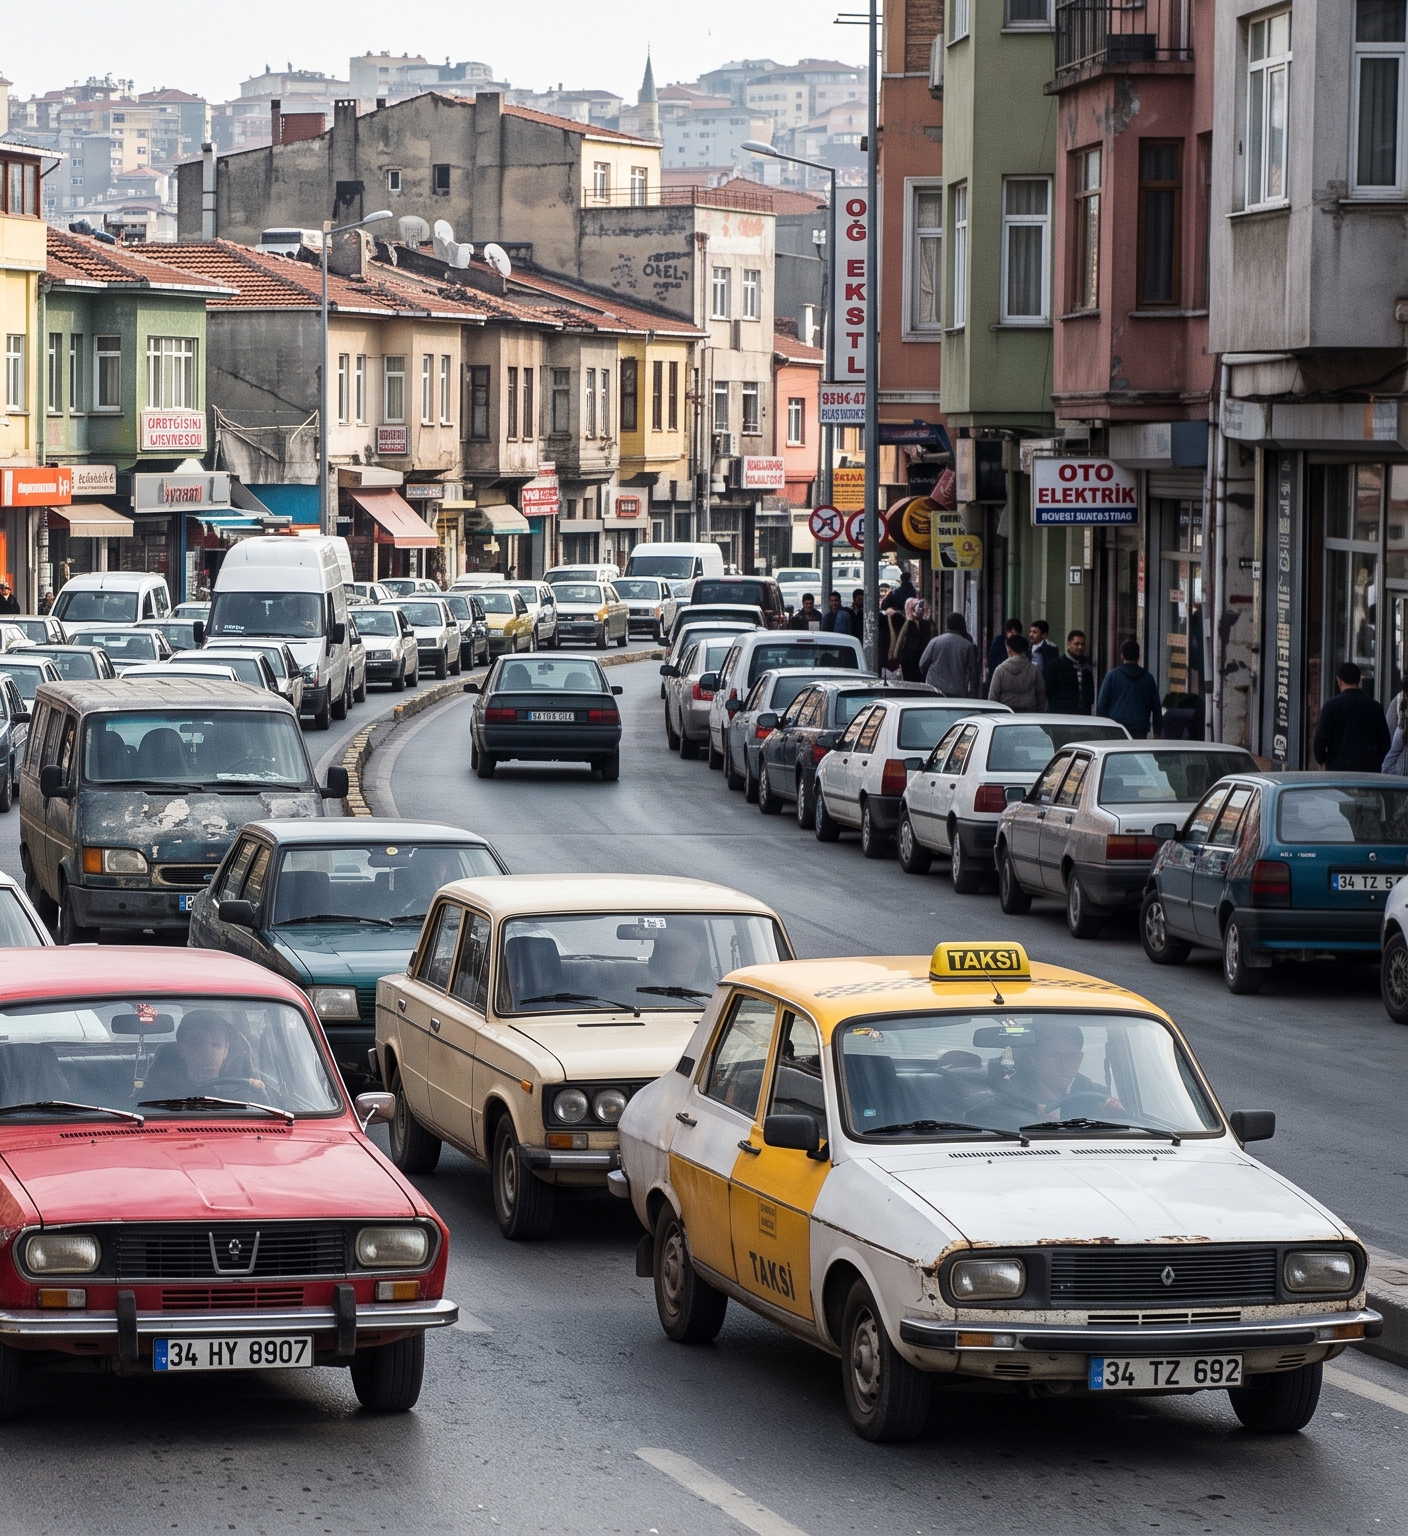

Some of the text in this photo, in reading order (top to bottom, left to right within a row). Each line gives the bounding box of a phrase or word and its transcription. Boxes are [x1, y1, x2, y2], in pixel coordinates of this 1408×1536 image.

[1058, 464, 1114, 482] OTO
[1038, 483, 1135, 503] ELEKTRİK
[1340, 876, 1355, 888] 34
[1362, 876, 1378, 888] TZ
[749, 1250, 796, 1301] TAKSİ
[170, 1339, 308, 1366] 34 HY 8907
[1105, 1358, 1240, 1386] 34 TZ 692
